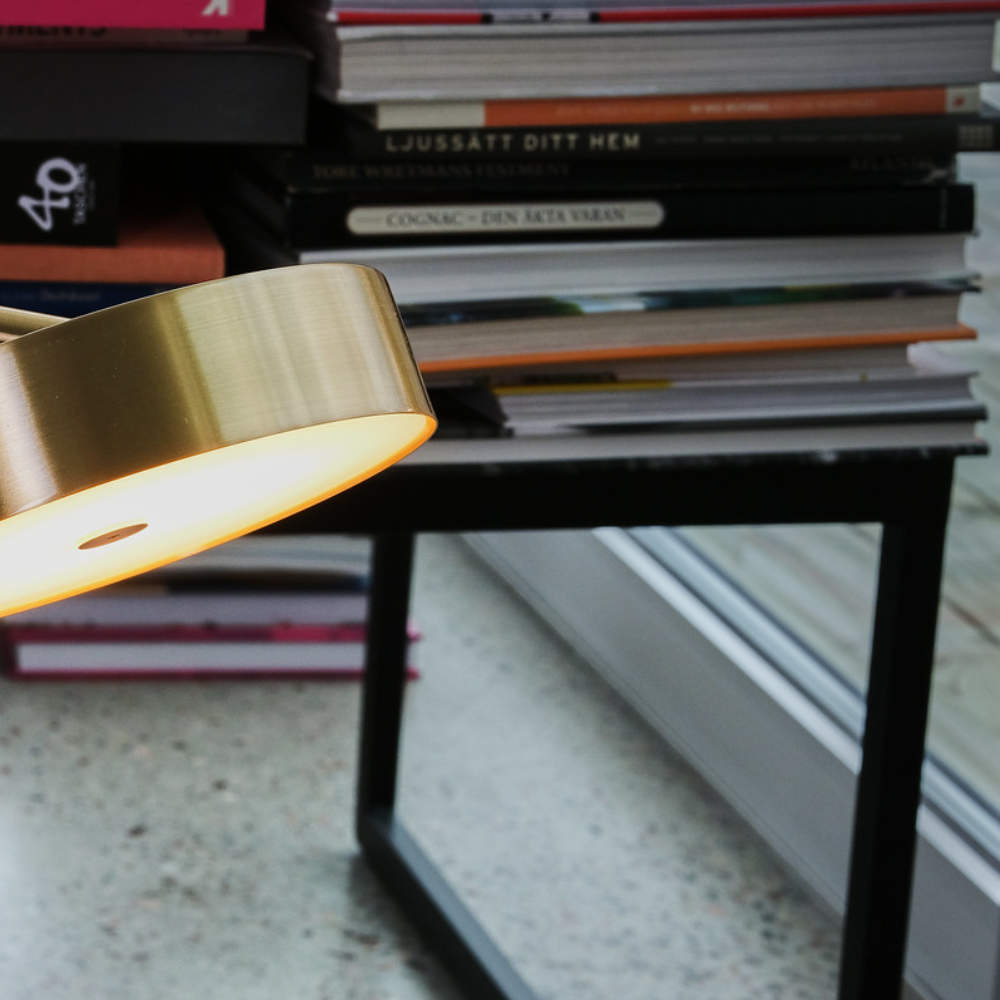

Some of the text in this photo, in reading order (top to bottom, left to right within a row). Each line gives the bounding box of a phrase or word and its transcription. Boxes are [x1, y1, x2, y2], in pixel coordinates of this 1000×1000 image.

[385, 131, 513, 152] LJUSSÄTT
[523, 132, 580, 152] DITT
[589, 132, 641, 151] HEM
[16, 156, 80, 232] 40
